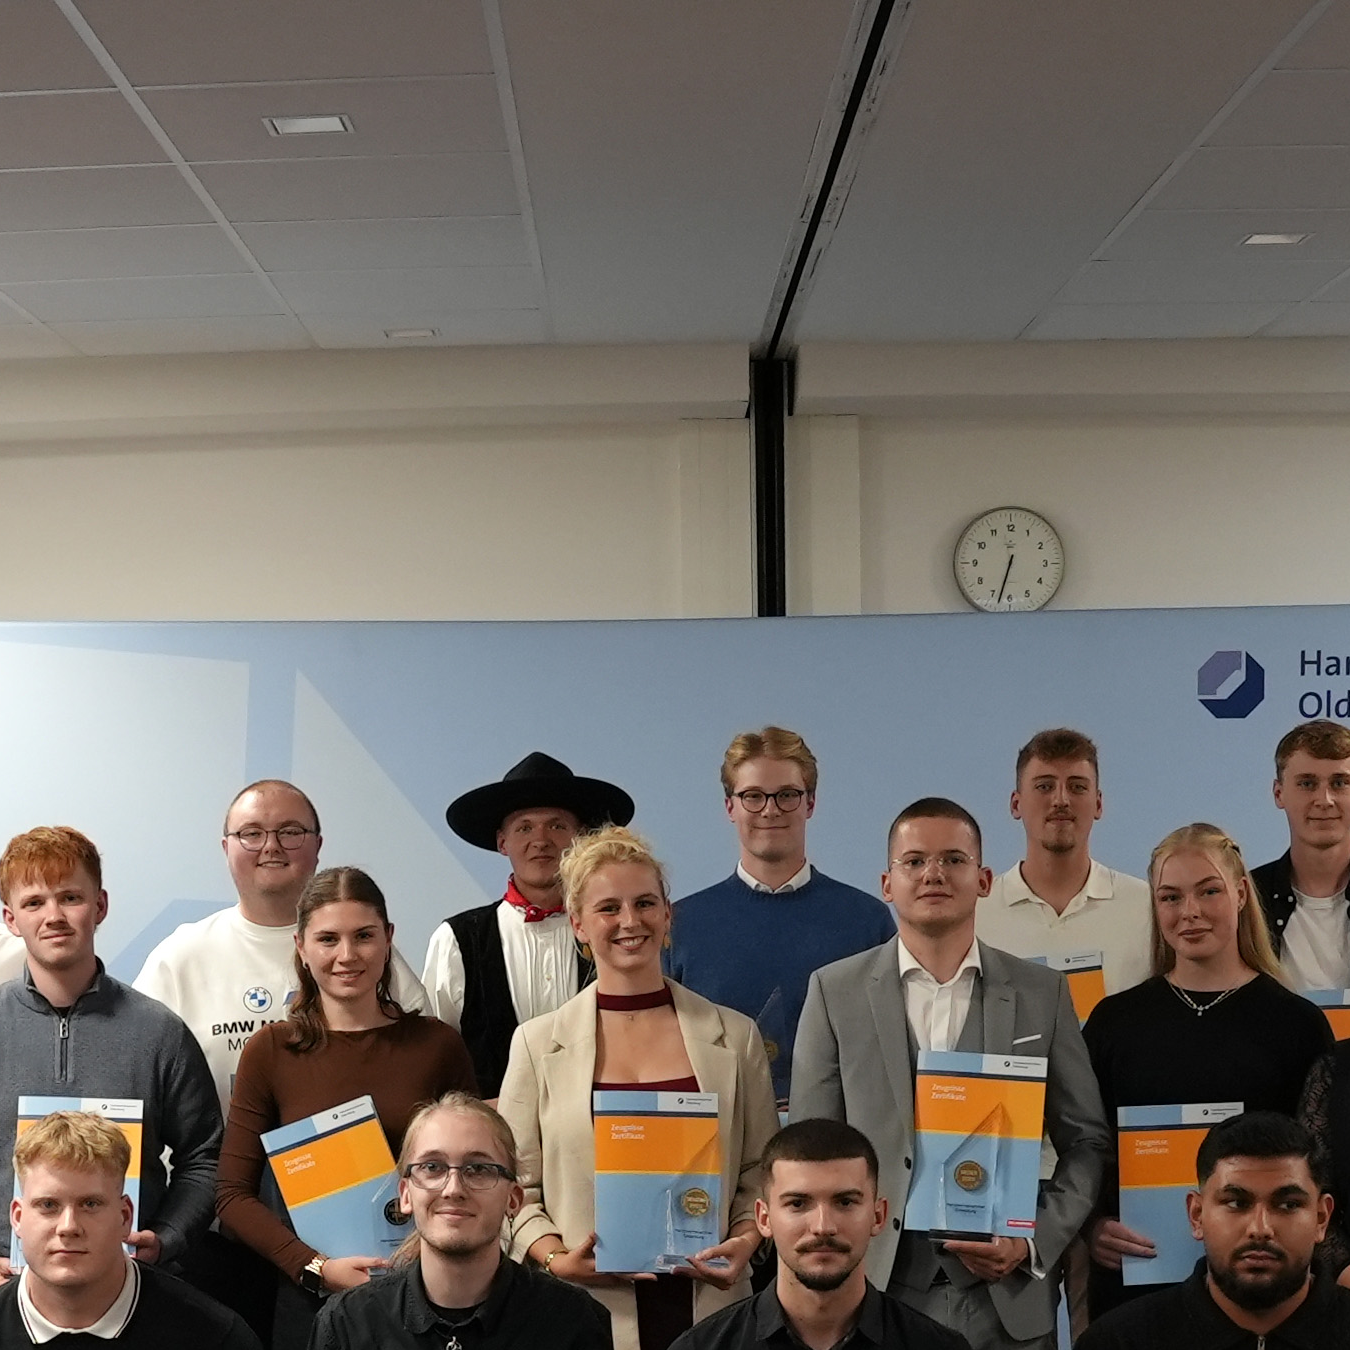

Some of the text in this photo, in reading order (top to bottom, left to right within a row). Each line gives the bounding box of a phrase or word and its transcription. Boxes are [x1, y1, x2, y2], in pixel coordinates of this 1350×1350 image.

[1007, 524, 1015, 532] 12
[977, 542, 986, 550] 10
[1037, 542, 1043, 550] 2
[972, 559, 978, 567] 9
[1007, 594, 1012, 602] 6
[212, 1020, 255, 1036] BMW
